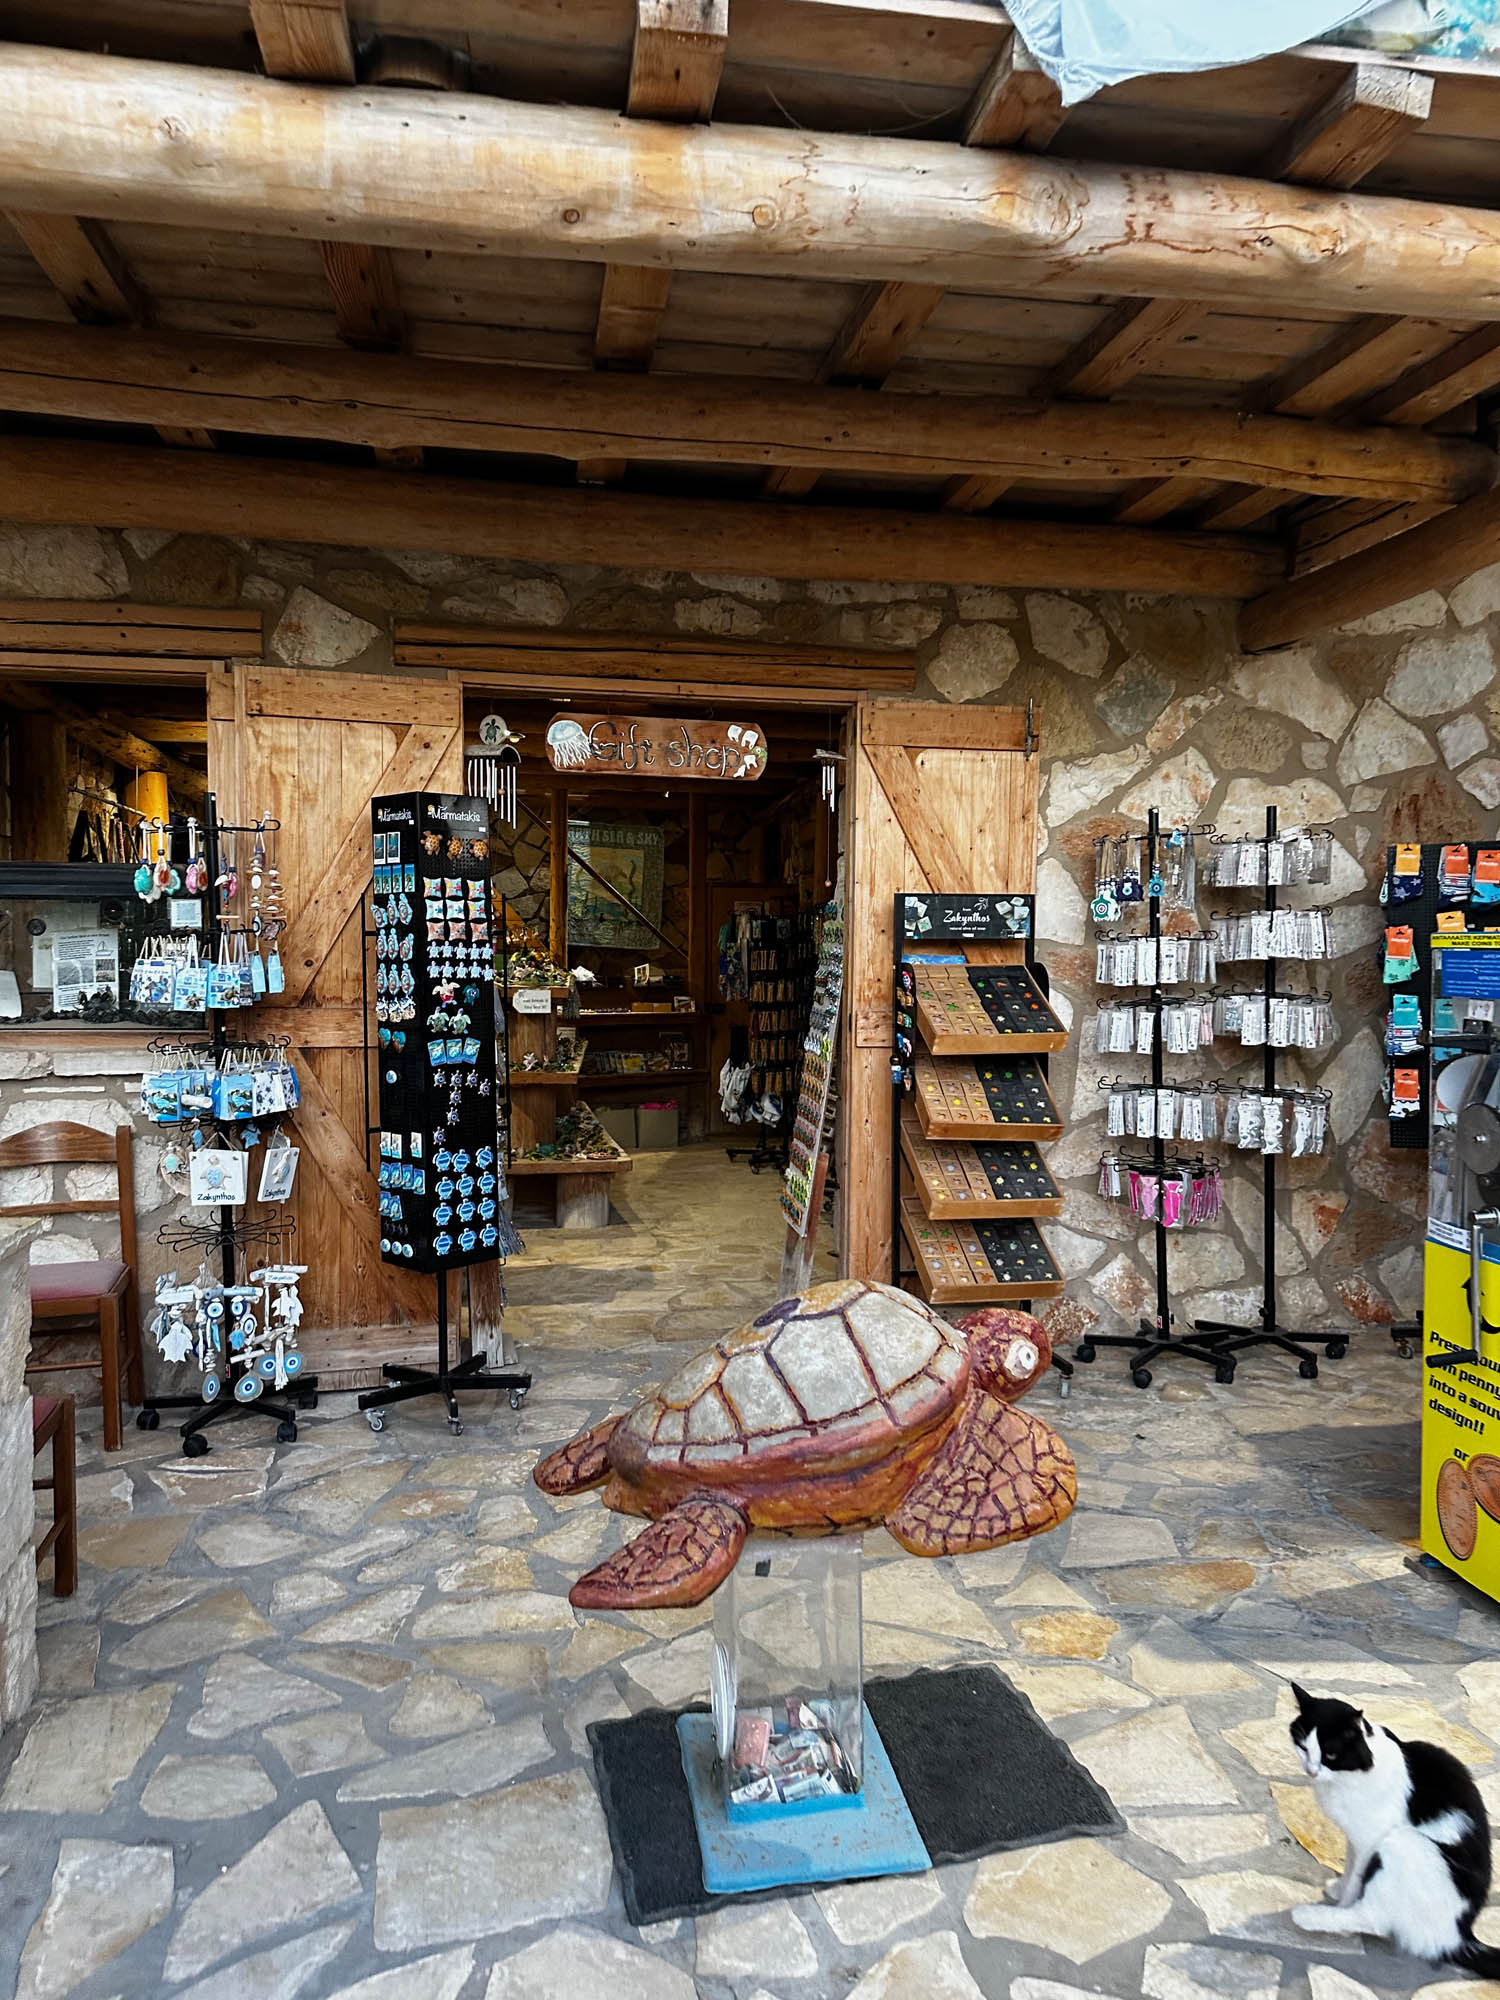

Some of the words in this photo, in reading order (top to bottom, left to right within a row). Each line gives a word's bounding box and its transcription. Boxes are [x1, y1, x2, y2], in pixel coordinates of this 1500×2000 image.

[589, 721, 655, 770] Gift
[666, 726, 741, 777] shop
[431, 806, 481, 822] Marmatakis
[637, 832, 660, 845] SKY
[943, 909, 990, 926] Zakynthos
[197, 1191, 236, 1203] Zakynthos
[1429, 1330, 1465, 1352] Pres
[1429, 1374, 1456, 1397] into
[1458, 1391, 1467, 1404] a
[1429, 1398, 1485, 1435] design!!
[1454, 1447, 1470, 1461] or
